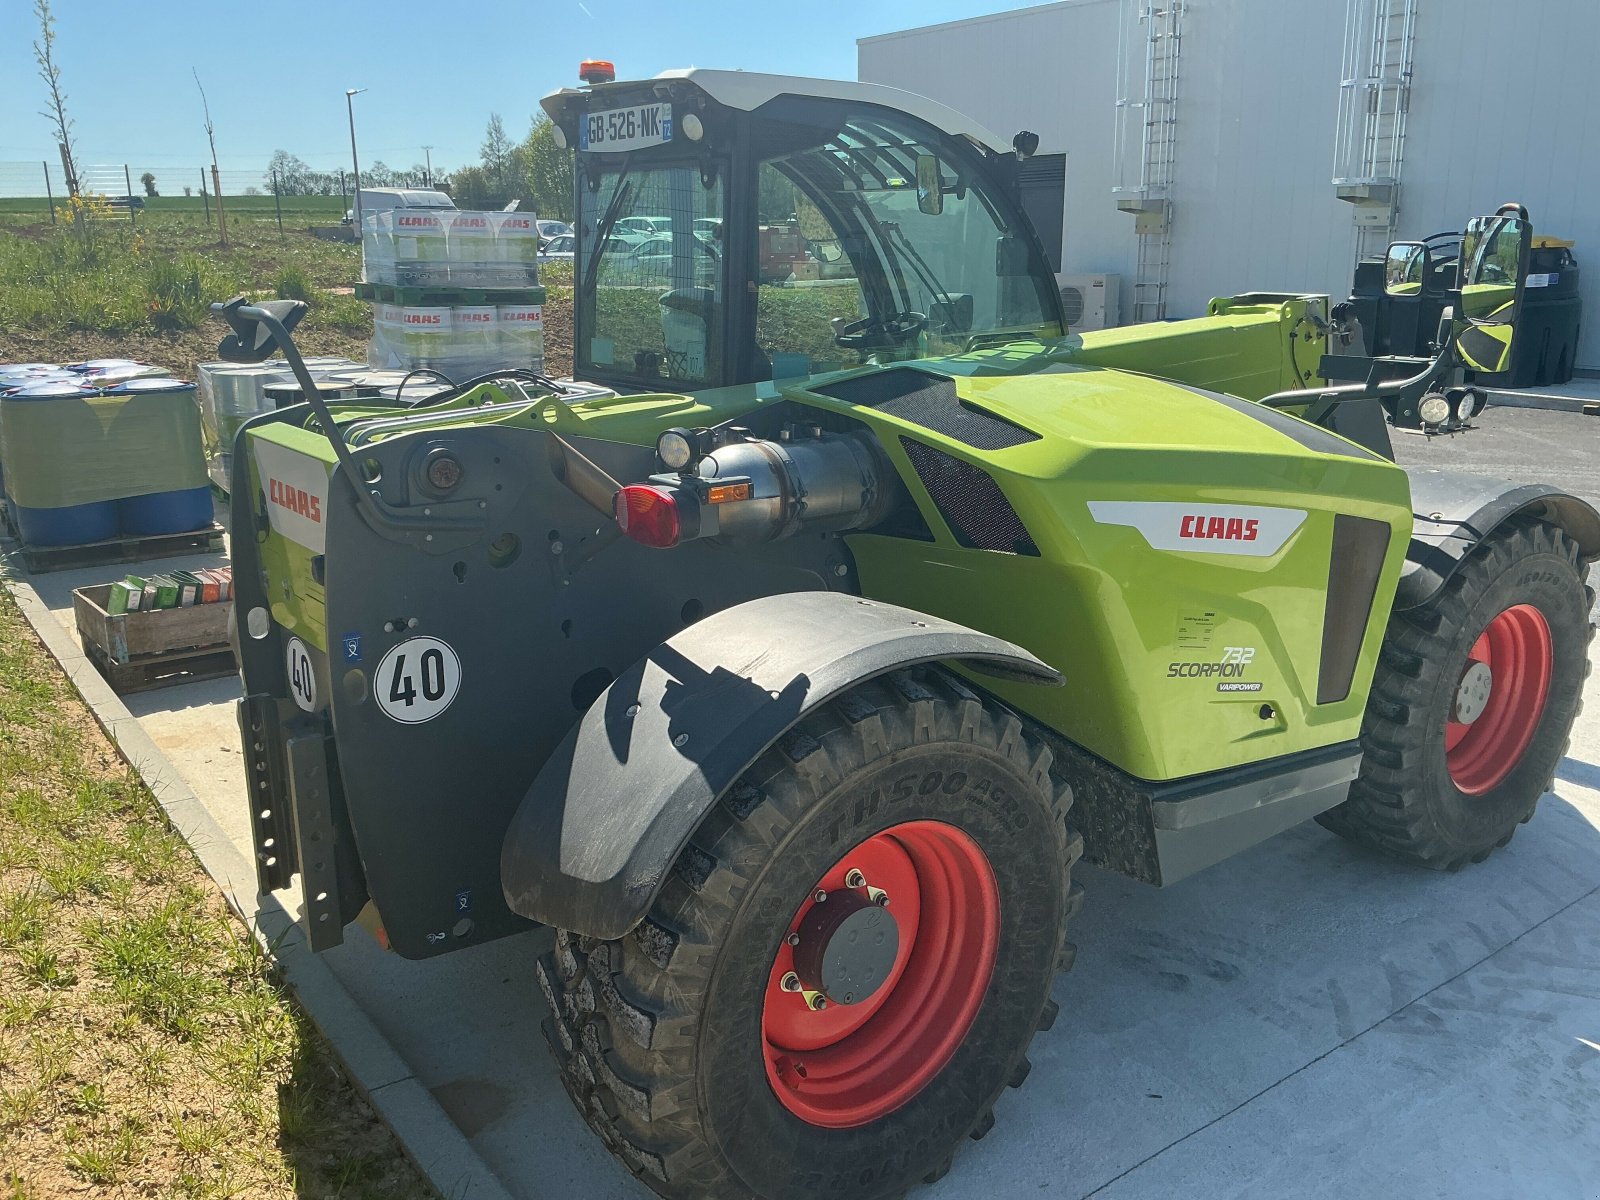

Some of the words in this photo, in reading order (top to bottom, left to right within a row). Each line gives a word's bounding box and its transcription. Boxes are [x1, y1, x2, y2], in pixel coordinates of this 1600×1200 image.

[663, 123, 671, 137] 72
[270, 478, 321, 523] CLAAS
[1179, 515, 1259, 541] CLAAS
[1221, 646, 1255, 664] 732
[292, 648, 312, 703] 40
[389, 648, 446, 707] 40
[1166, 663, 1246, 678] SCORPION
[1219, 683, 1261, 691] VARIPOWER
